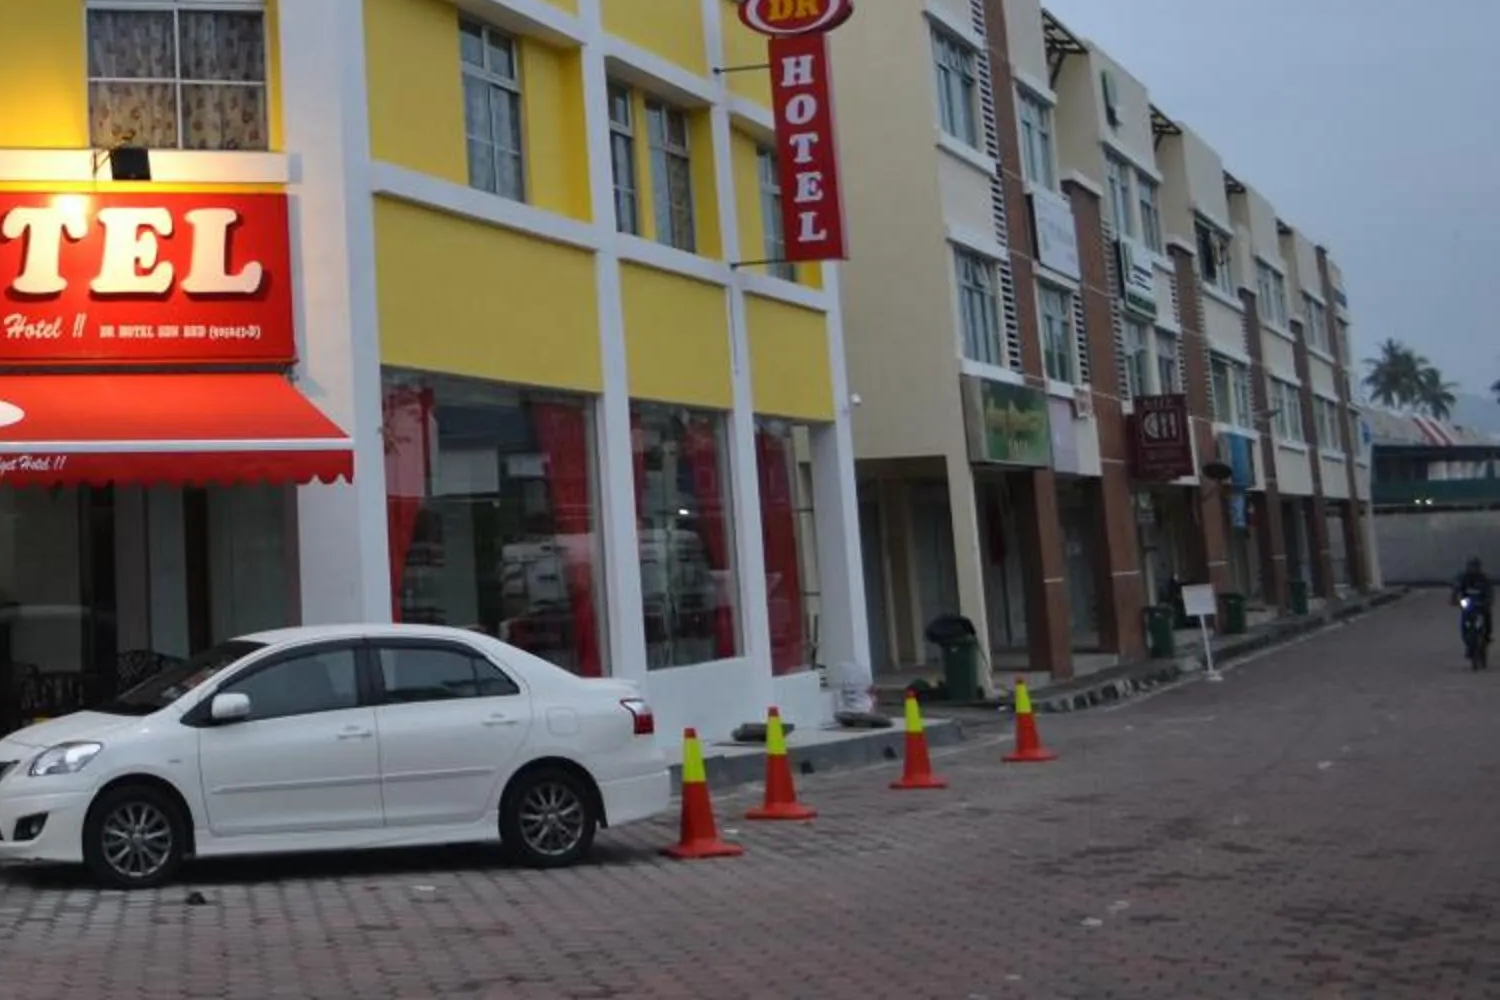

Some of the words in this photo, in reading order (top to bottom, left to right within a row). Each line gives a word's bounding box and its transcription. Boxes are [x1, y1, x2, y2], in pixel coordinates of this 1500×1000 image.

[781, 54, 827, 242] HOTEL
[3, 313, 62, 339] Hotel
[118, 325, 155, 338] HOTEL
[19, 455, 51, 471] Hotel
